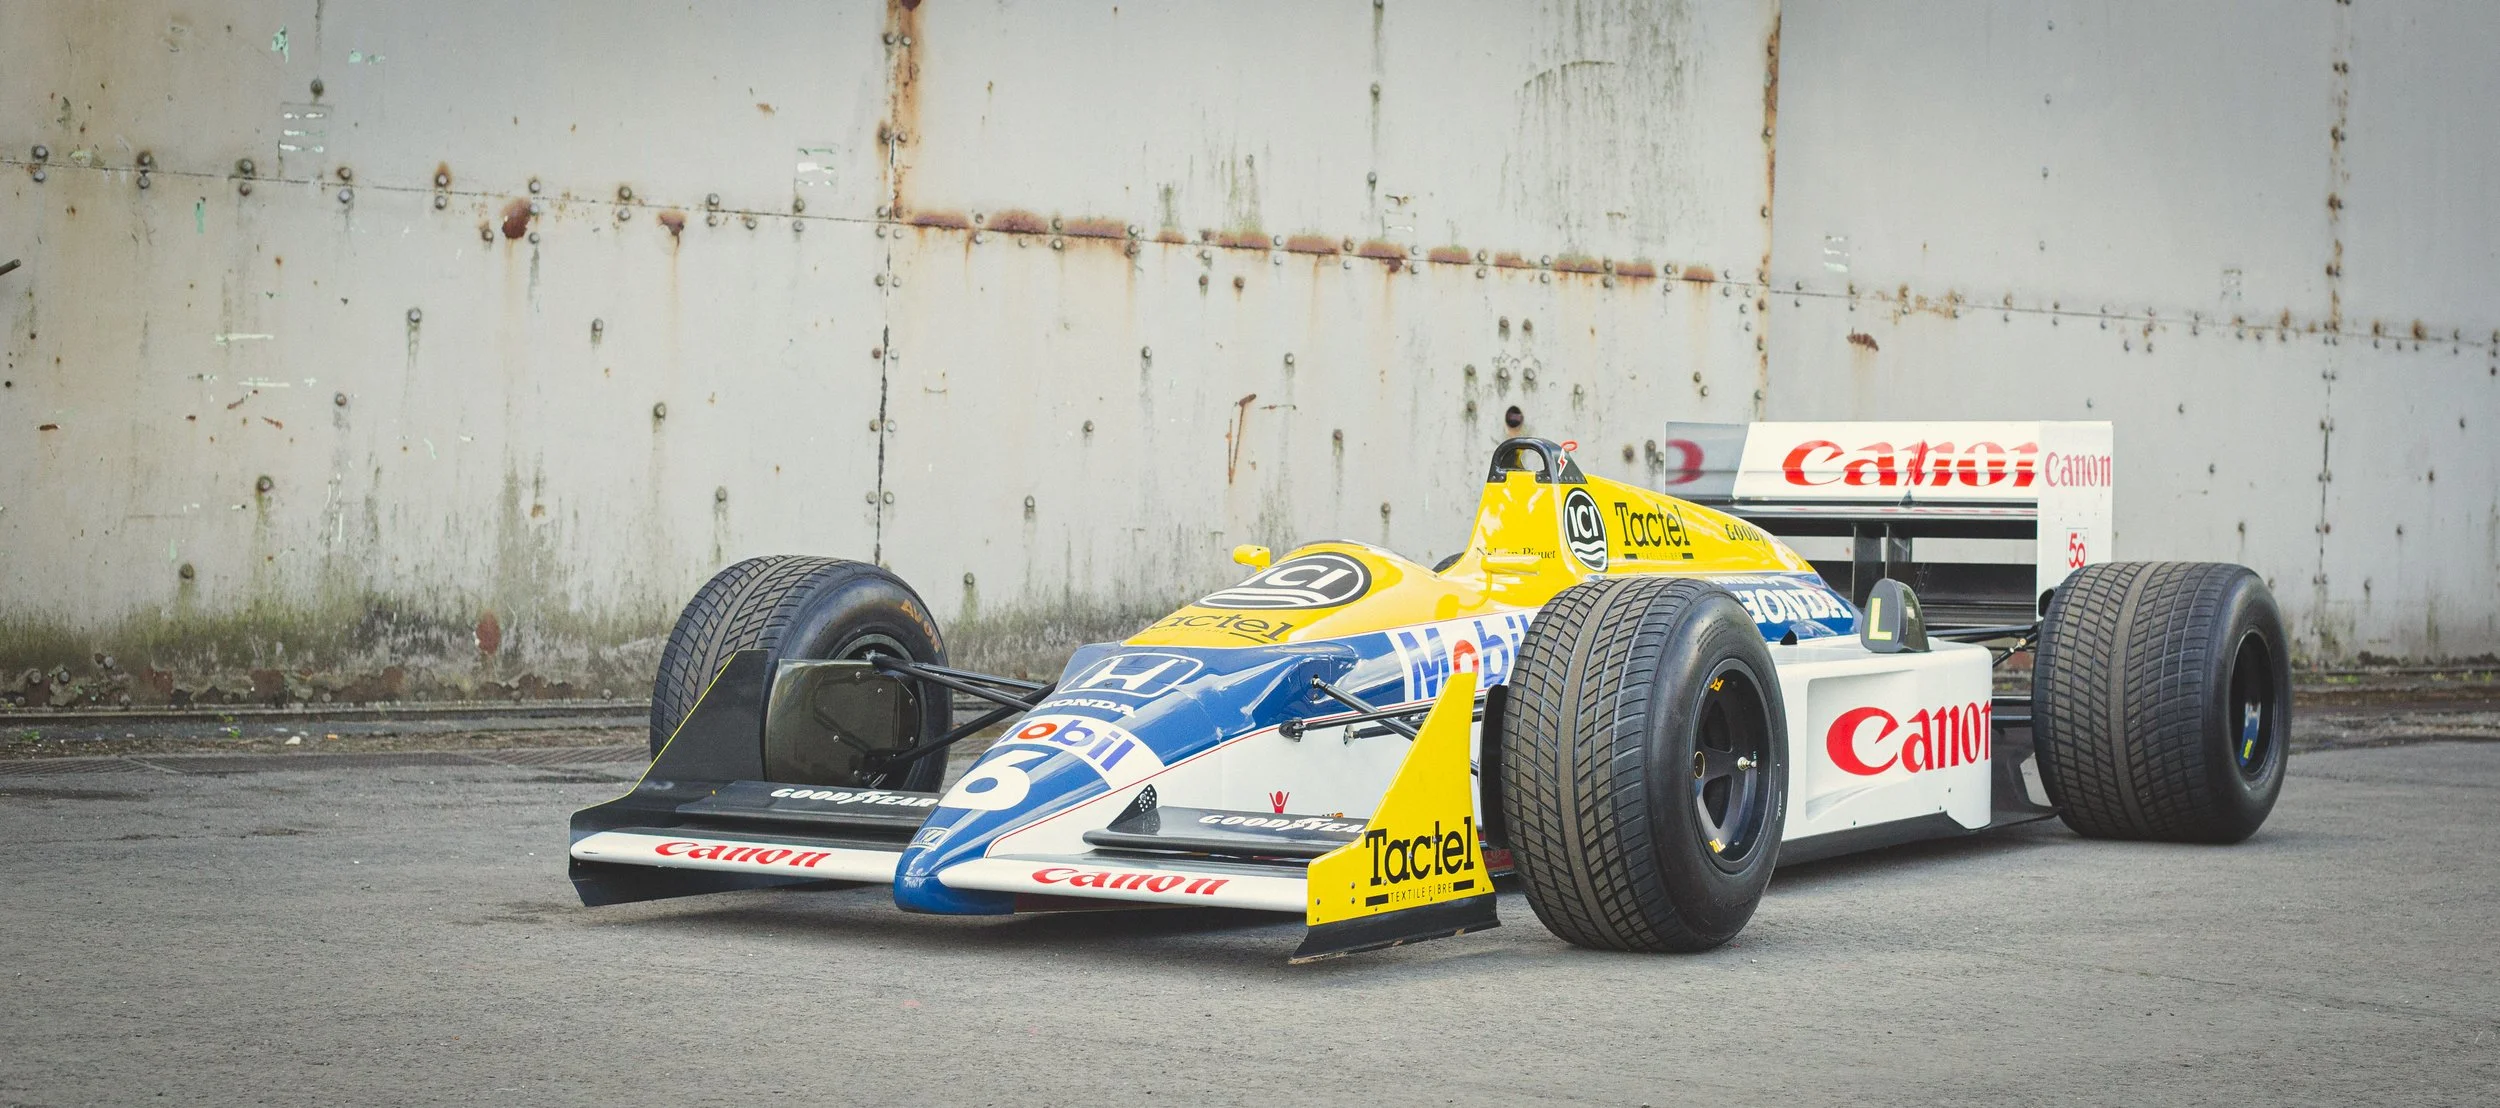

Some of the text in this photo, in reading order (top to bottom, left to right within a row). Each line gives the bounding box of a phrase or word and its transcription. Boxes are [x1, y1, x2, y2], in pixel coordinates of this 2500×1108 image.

[2045, 452, 2111, 487] Canon
[1568, 505, 1598, 538] ICI
[1614, 501, 1691, 547] Tactel
[1236, 565, 1353, 590] ICI
[1733, 587, 1853, 625] HONDA
[1868, 597, 1892, 641] L
[901, 599, 941, 654] AVON
[1152, 612, 1293, 641] actel
[1397, 614, 1530, 701] Mobi
[938, 749, 1049, 811] 6
[770, 788, 939, 808] GOODYEAR
[655, 841, 832, 868] Canon
[1364, 816, 1475, 887] Tactel
[1031, 867, 1230, 895] Canon
[1390, 882, 1453, 903] TEXTILE FIBRE
